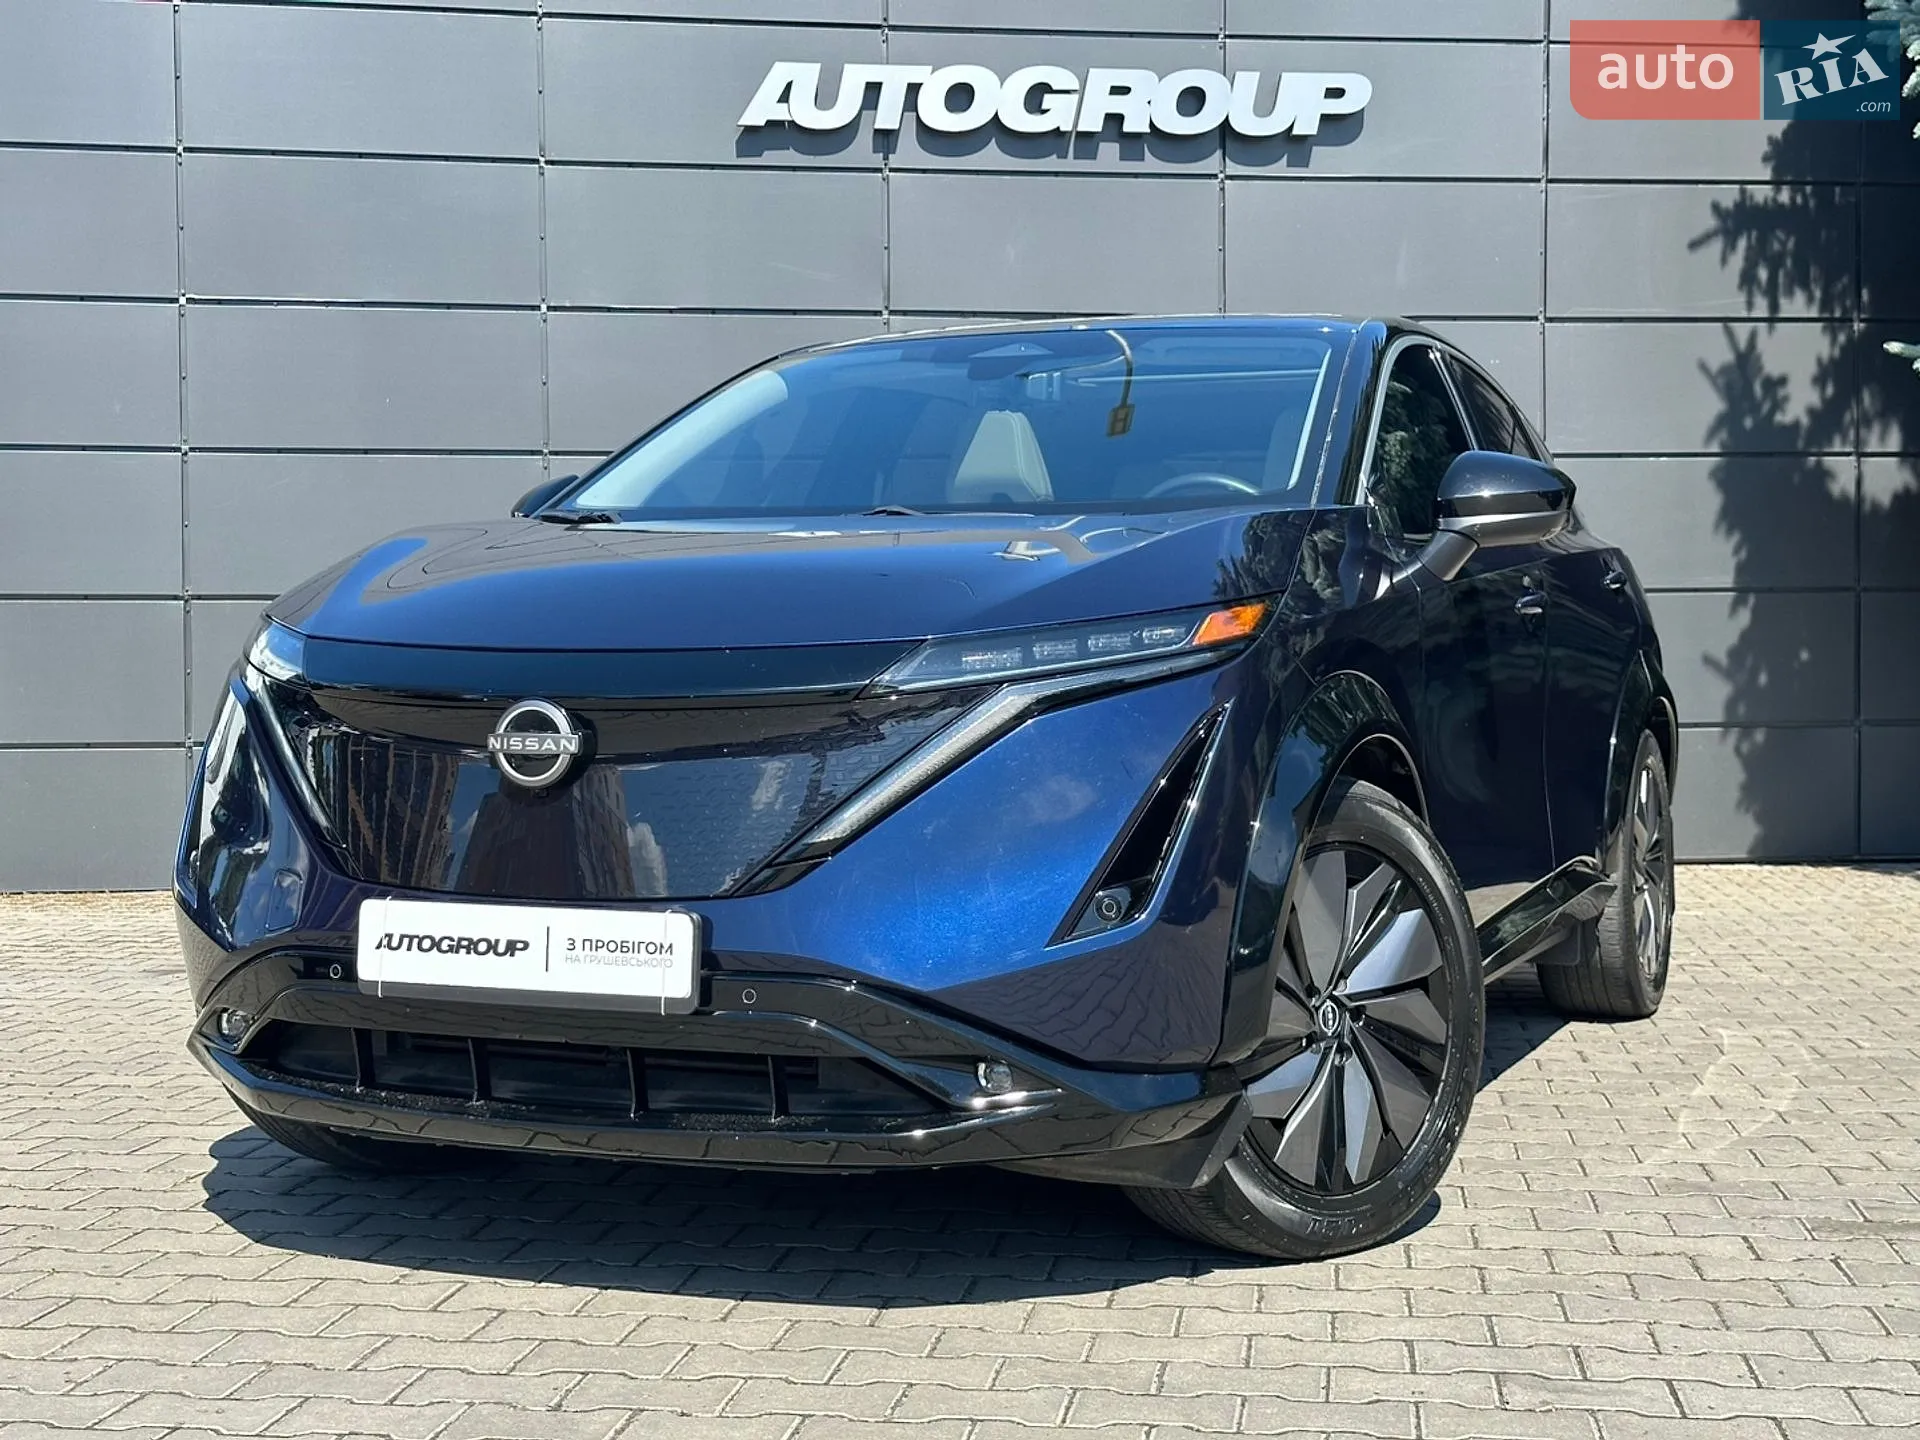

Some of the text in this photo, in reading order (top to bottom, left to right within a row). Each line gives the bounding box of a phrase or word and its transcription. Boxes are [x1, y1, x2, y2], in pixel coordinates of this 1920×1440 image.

[736, 61, 1373, 138] AUTOGROUP
[488, 737, 576, 751] NISSAN
[374, 932, 530, 958] AUTOGROUP
[582, 938, 674, 956] ПРОБІГОМ
[565, 953, 674, 969] НА ГРУШЕВСЬКОГО
